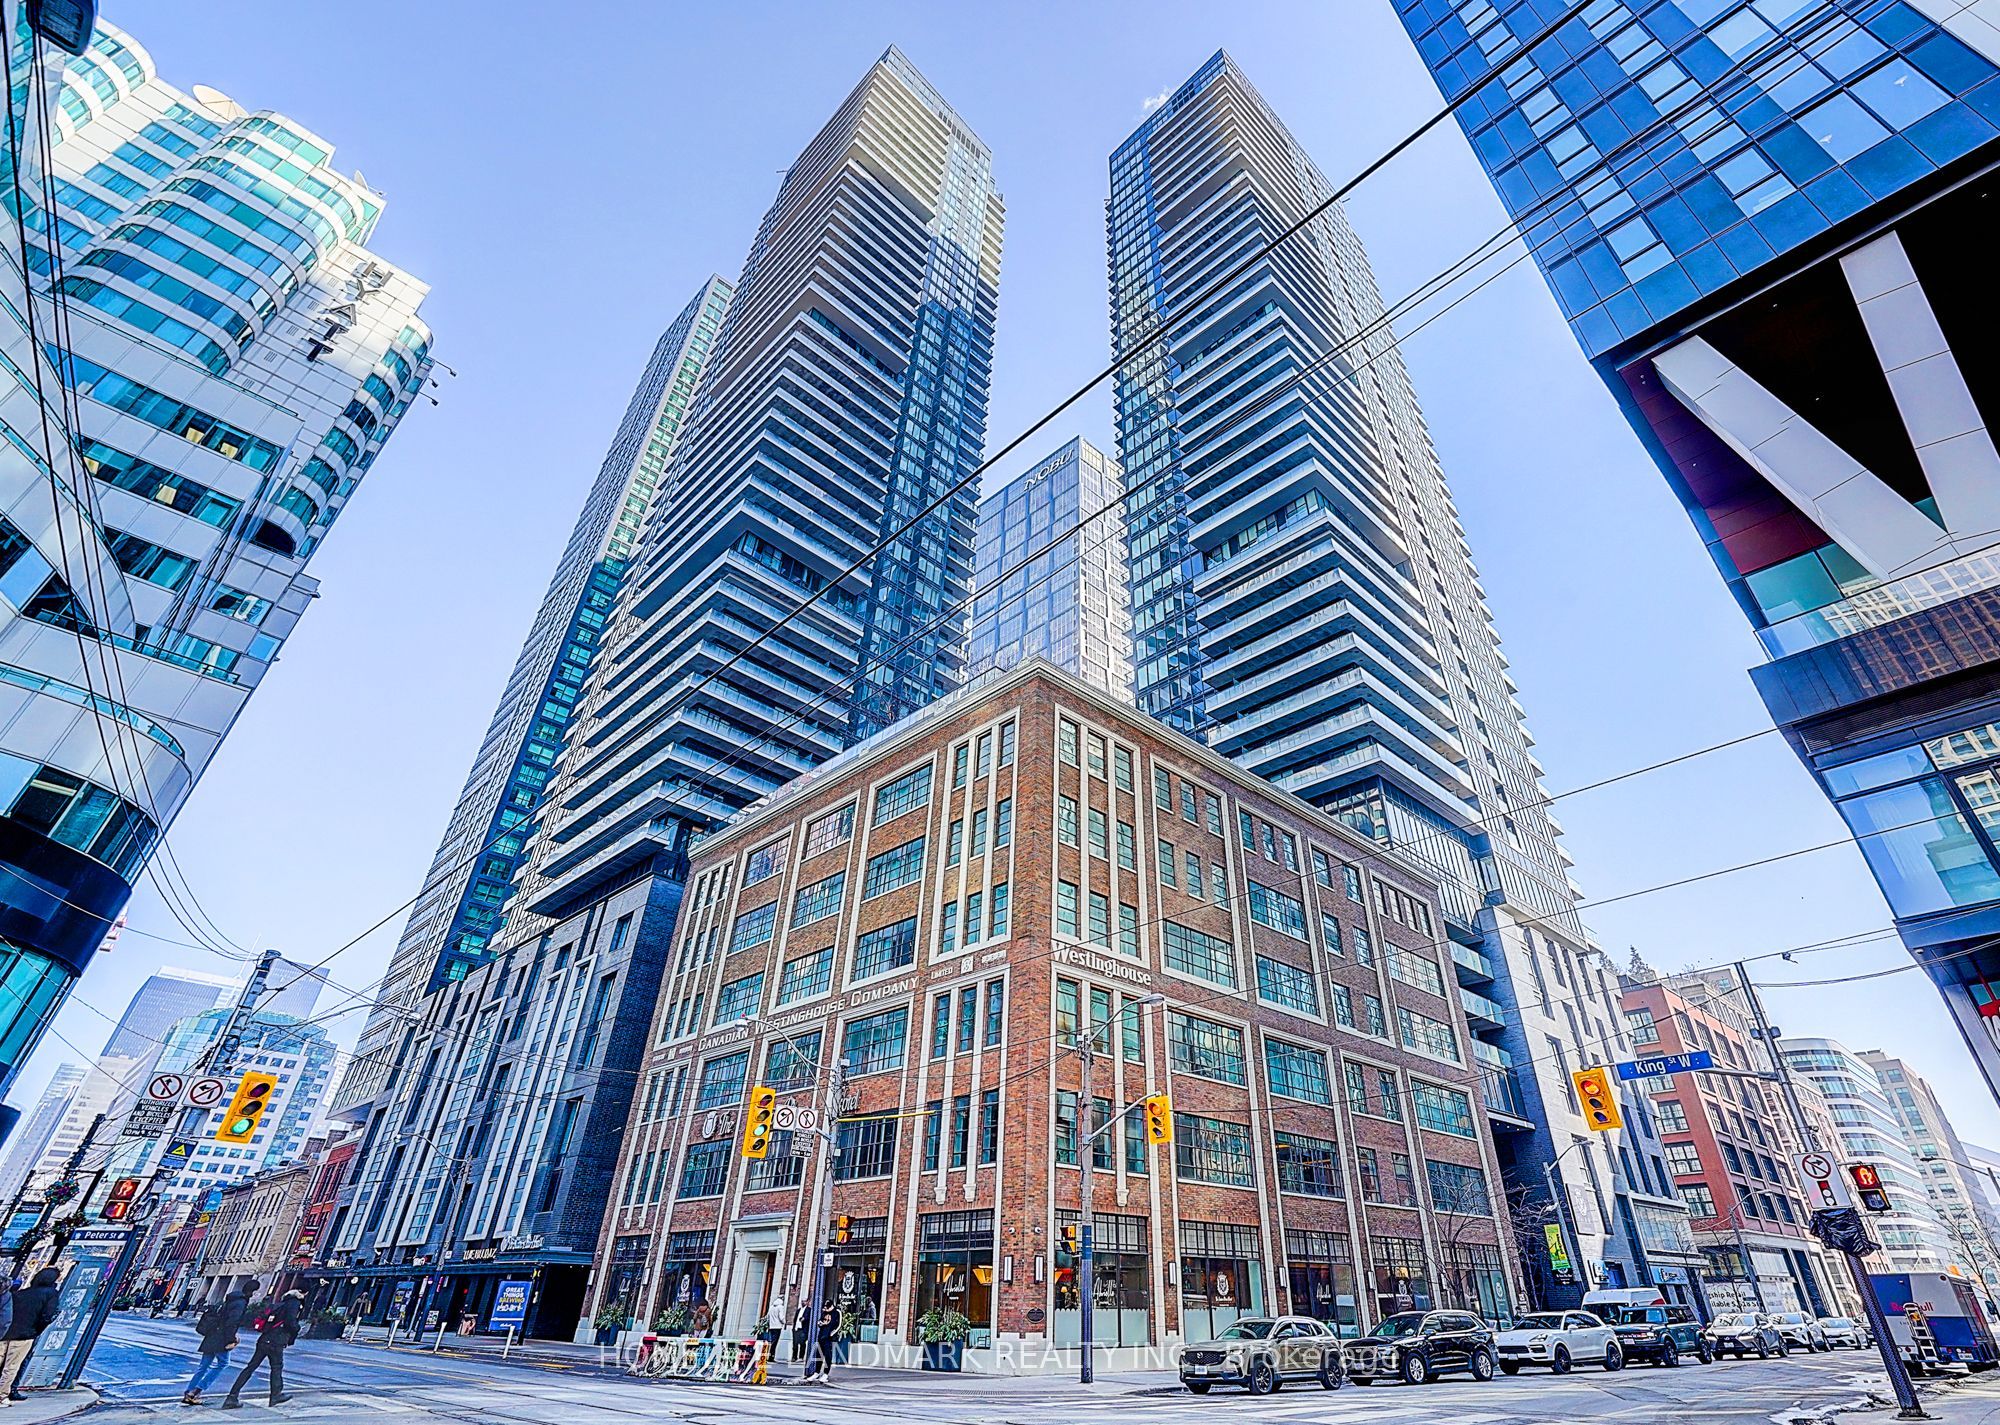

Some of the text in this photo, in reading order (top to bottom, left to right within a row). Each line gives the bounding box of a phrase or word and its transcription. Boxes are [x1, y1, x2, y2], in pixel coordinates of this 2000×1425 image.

[306, 261, 394, 362] HYATT
[1024, 448, 1074, 491] NOBU
[1050, 940, 1151, 986] Westinghouse
[699, 1025, 749, 1052] CANADIAN
[754, 998, 846, 1033] WESTINGHOUSE
[851, 975, 919, 1007] COMPANY
[1634, 1060, 1666, 1075] King
[1677, 1054, 1691, 1068] W
[141, 1104, 170, 1113] VEHICLES
[84, 1231, 109, 1240] Peter
